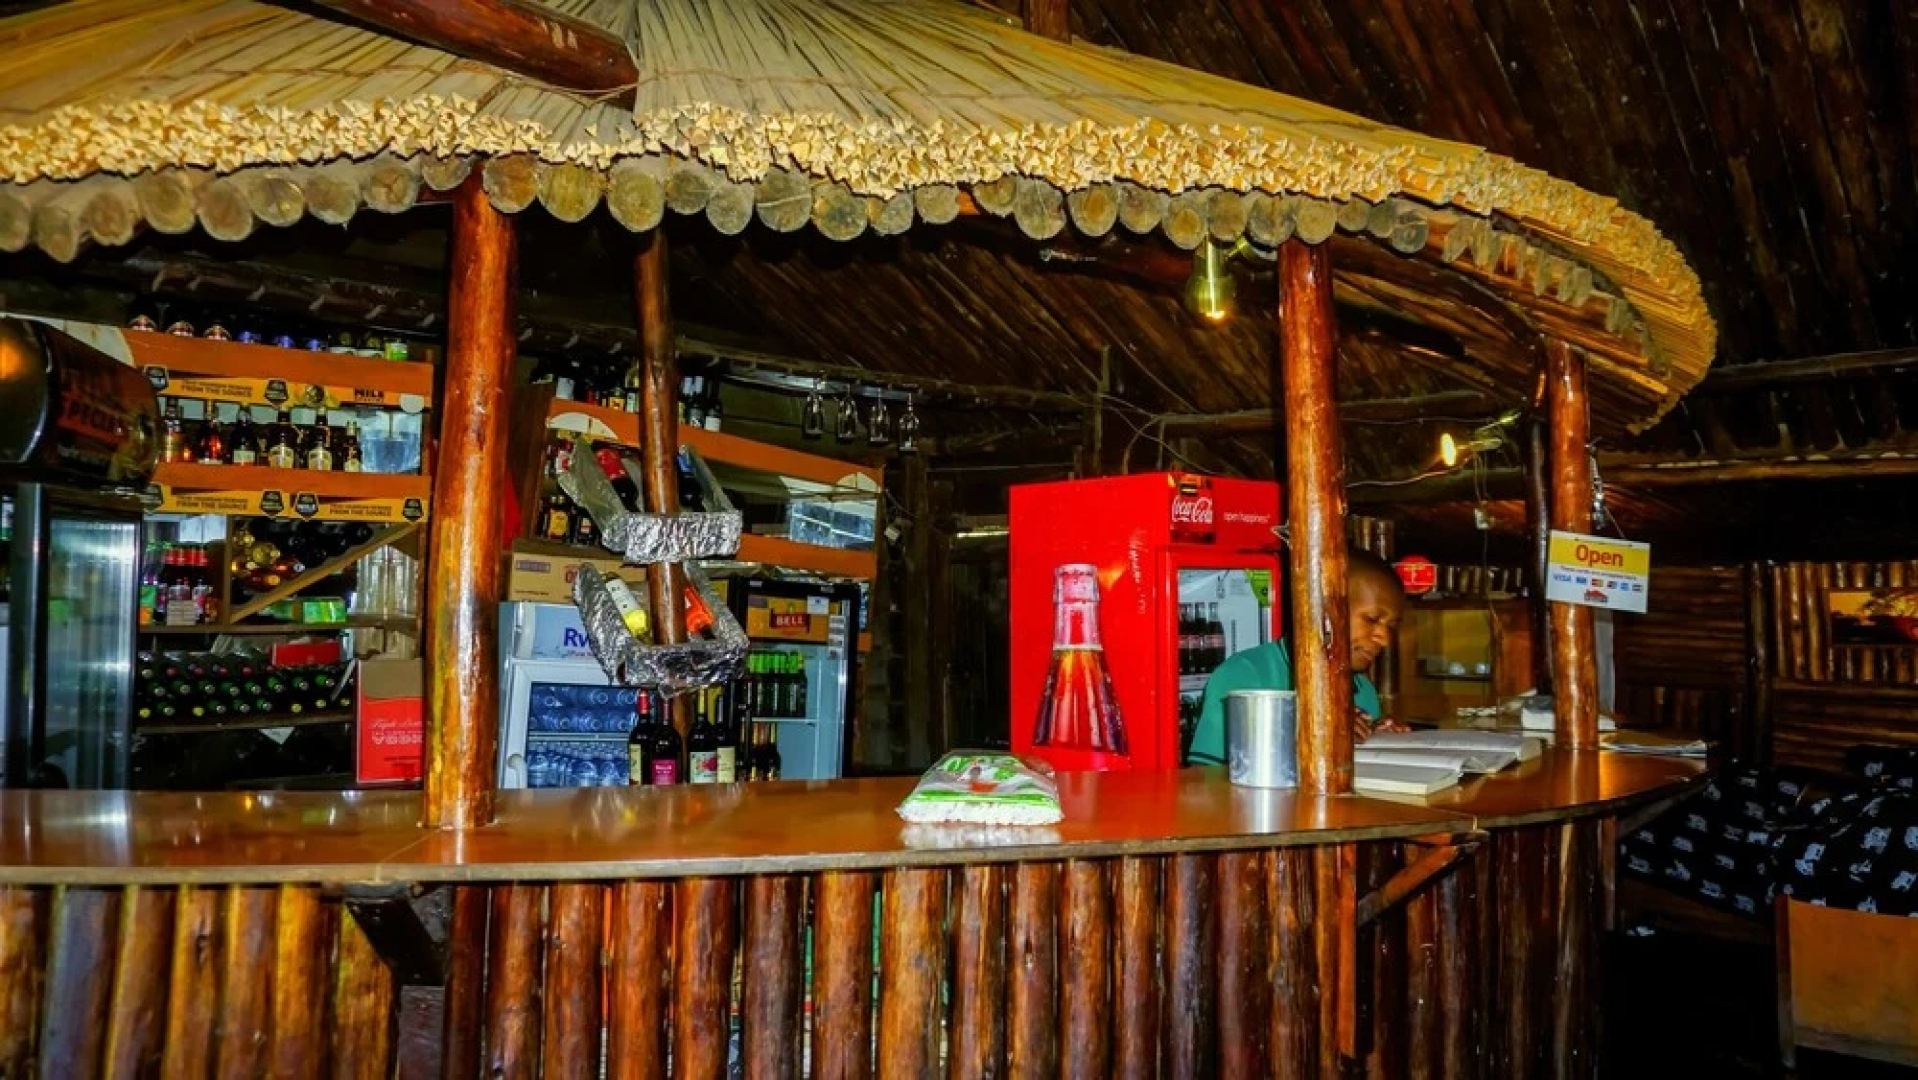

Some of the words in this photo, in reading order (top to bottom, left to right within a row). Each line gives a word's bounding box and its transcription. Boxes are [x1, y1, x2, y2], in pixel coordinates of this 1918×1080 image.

[1576, 544, 1624, 567] Open
[776, 614, 804, 626] BELL
[564, 626, 591, 649] Rw
